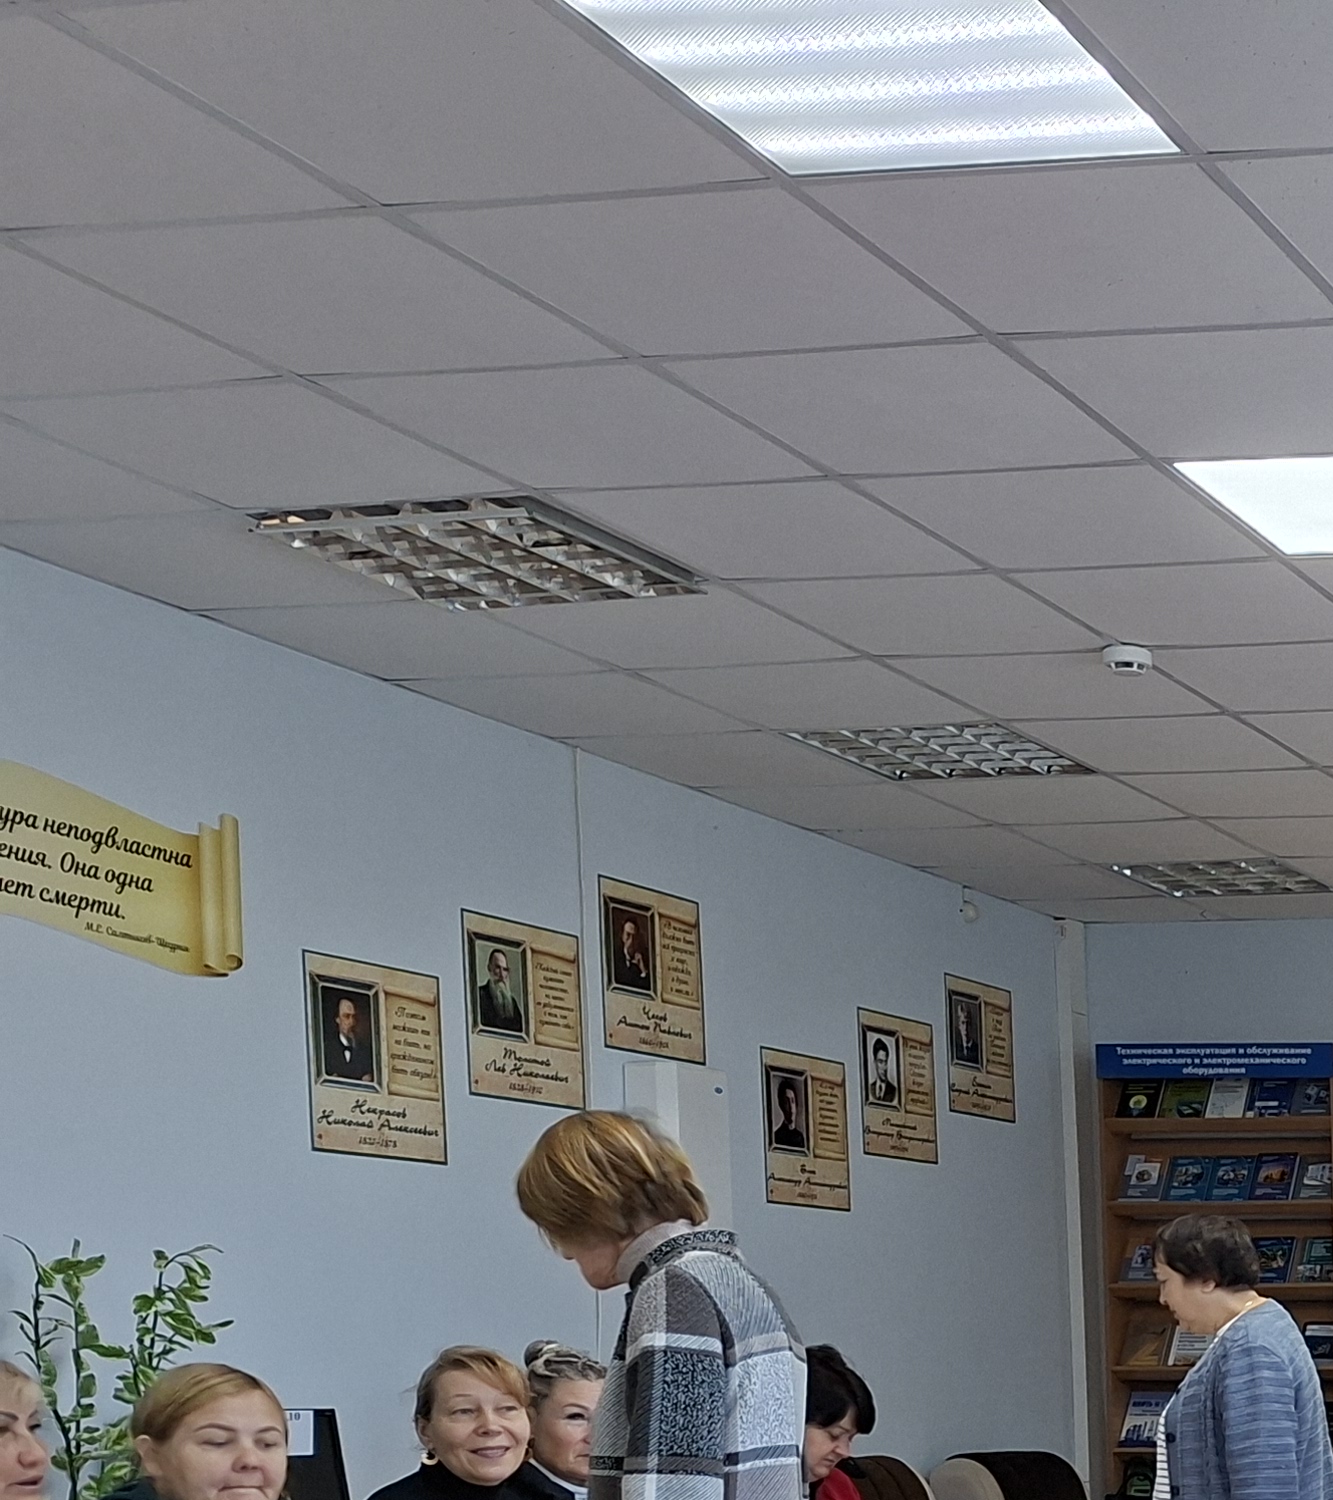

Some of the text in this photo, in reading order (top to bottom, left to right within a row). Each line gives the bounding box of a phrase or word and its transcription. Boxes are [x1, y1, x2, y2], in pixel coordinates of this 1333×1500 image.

[43, 817, 193, 869] неподвластна
[60, 852, 100, 880] Она
[104, 868, 154, 895] одна
[39, 887, 126, 920] смерти.
[1116, 1047, 1173, 1056] Техническая
[1176, 1047, 1236, 1057] эксплуатация
[1246, 1046, 1312, 1056] обслуживание
[1122, 1057, 1192, 1066] электрического
[1202, 1057, 1307, 1066] электромеханического
[1182, 1066, 1246, 1075] оборудования
